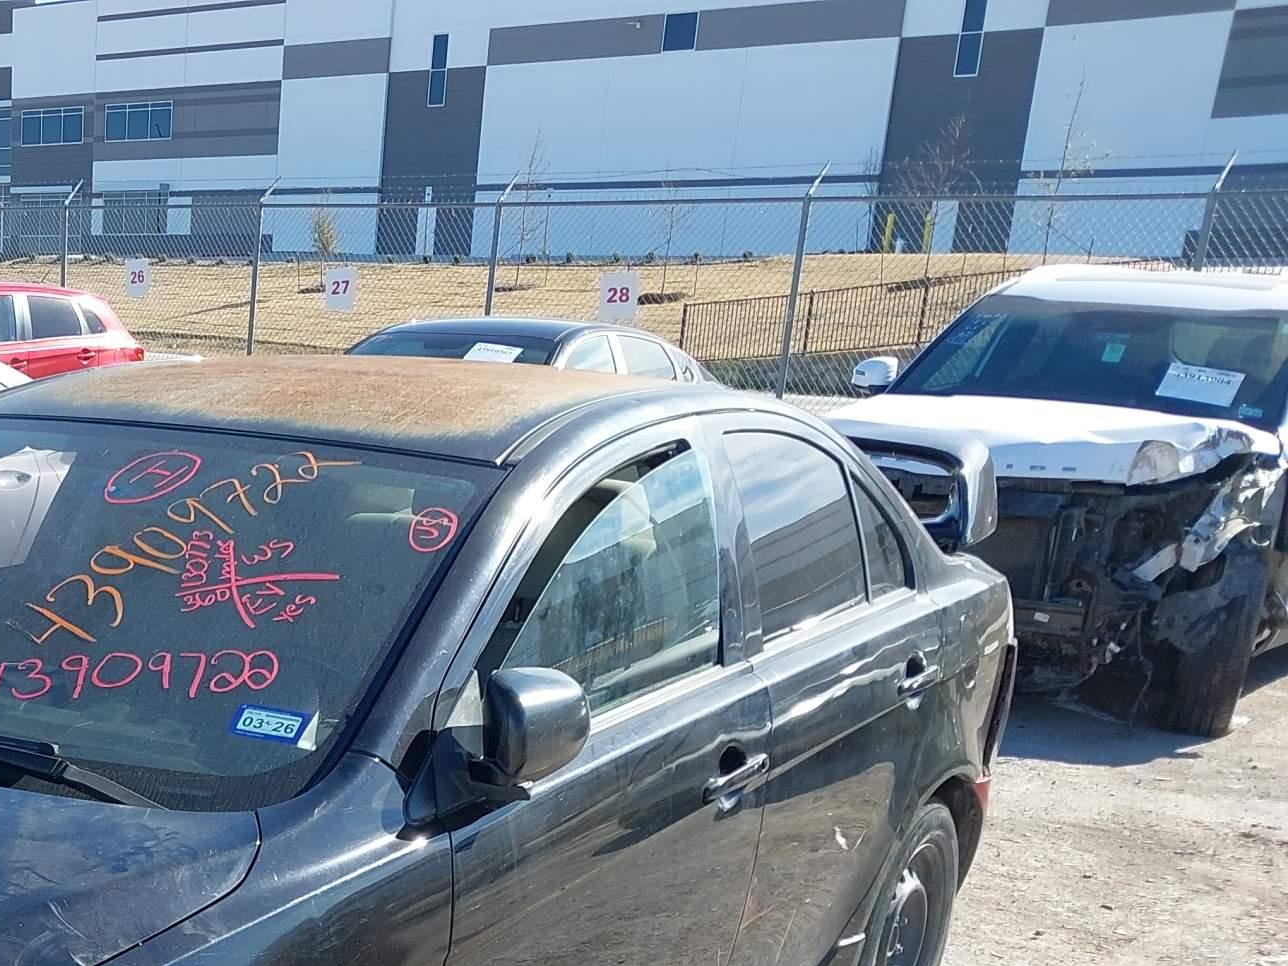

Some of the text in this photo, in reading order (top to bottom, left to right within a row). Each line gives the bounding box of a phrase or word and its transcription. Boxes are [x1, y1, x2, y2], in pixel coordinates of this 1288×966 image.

[130, 270, 145, 285] 26
[331, 279, 350, 295] 27
[606, 286, 630, 304] 28
[7, 450, 362, 645] 43909722
[242, 716, 296, 735] 03 26
